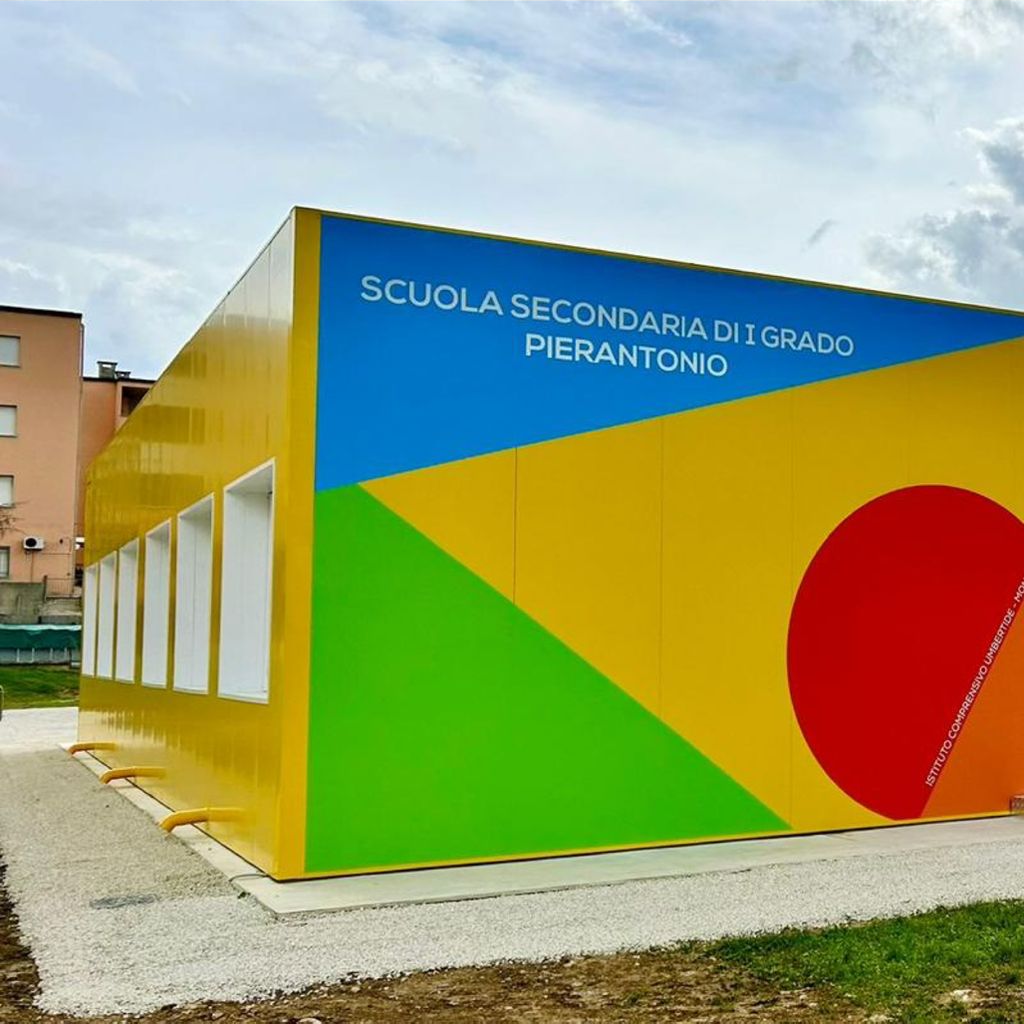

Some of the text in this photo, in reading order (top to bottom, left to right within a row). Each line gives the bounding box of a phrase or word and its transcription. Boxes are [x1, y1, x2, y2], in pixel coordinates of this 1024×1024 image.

[360, 275, 855, 357] SCUOLA SECONDARIA DI I GRADO
[525, 333, 728, 377] PIERANTONIO
[925, 739, 953, 787] ISTITUTO
[948, 665, 988, 739] COMPRENSIVO
[984, 608, 1016, 665] UMBERTIDE
